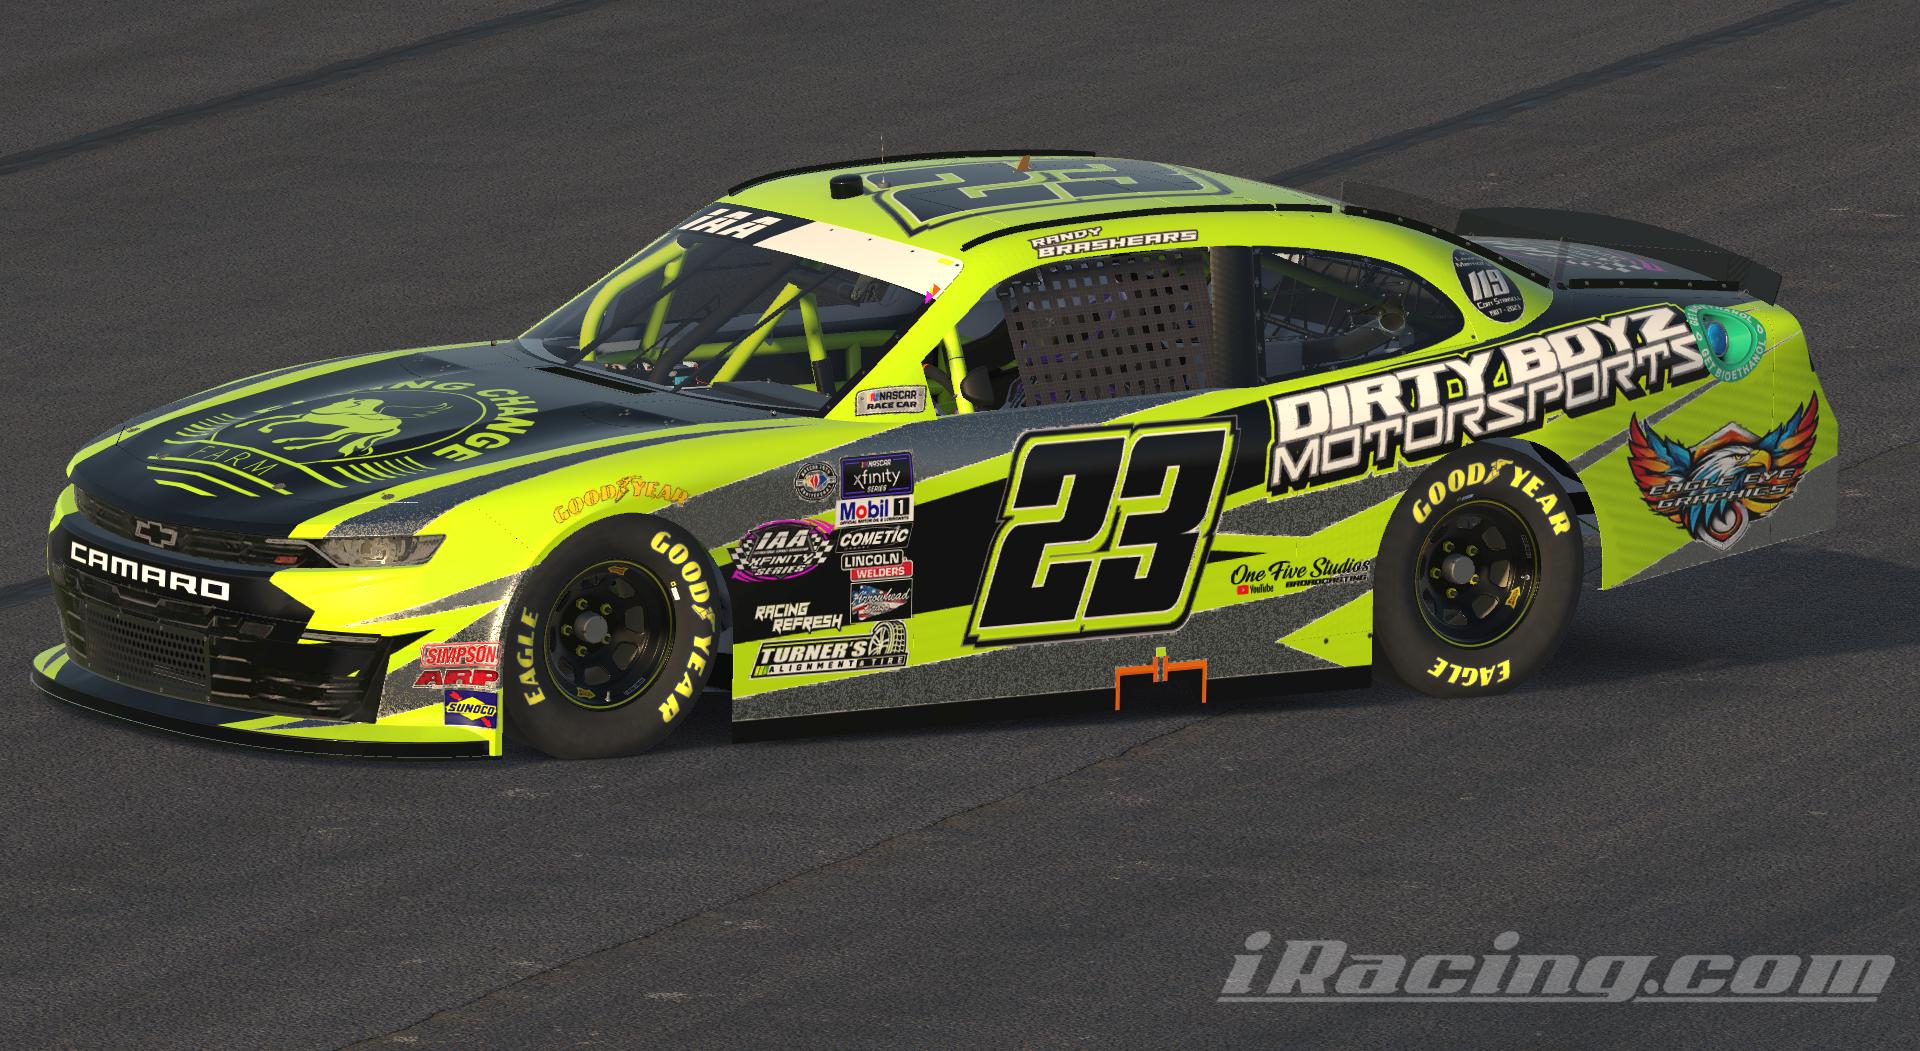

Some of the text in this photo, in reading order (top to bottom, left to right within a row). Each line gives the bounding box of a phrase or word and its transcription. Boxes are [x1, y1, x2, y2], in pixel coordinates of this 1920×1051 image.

[679, 208, 783, 239] IAA
[1030, 227, 1102, 248] RANDY
[1038, 230, 1198, 258] BRASHEARS
[1468, 269, 1510, 301] 119
[1701, 340, 1767, 381] GET BIOETHANOL
[1274, 305, 1690, 446] DIRTY BOYZ
[867, 402, 894, 410] RACE
[879, 390, 917, 400] NASCAR
[1271, 333, 1706, 488] MOTORSPORTS
[433, 388, 540, 462] CHANGE
[186, 444, 279, 477] FARM
[867, 458, 892, 468] NASCAR
[853, 468, 901, 490] xfinity
[866, 484, 888, 493] SERIES
[1649, 467, 1797, 497] EAGLE EYE
[1657, 484, 1788, 509] GRAPHICS
[840, 499, 889, 521] Mobil
[755, 529, 810, 551] IAA
[840, 526, 909, 548] COMETIC
[974, 424, 1230, 634] 23
[748, 552, 814, 567] XFINITY
[754, 564, 807, 576] SERIES
[844, 553, 900, 568] LINCOLN
[1231, 556, 1371, 585] One Five Studios
[70, 540, 230, 602] CAMARO
[856, 566, 905, 579] WELDERS
[1285, 574, 1368, 588] BROADCASTING
[1249, 582, 1274, 595] YouTube
[754, 601, 811, 622] RACING
[772, 613, 843, 635] REFRESH
[425, 645, 497, 665] SIMPSON
[516, 606, 546, 706] EAGLE
[761, 639, 869, 664] TURNER'S
[768, 659, 858, 674] ALIGNMENT
[871, 656, 904, 667] TIRE
[1426, 656, 1511, 687] EAGLE
[413, 669, 499, 687] ARP
[447, 702, 496, 717] SUNOCO
